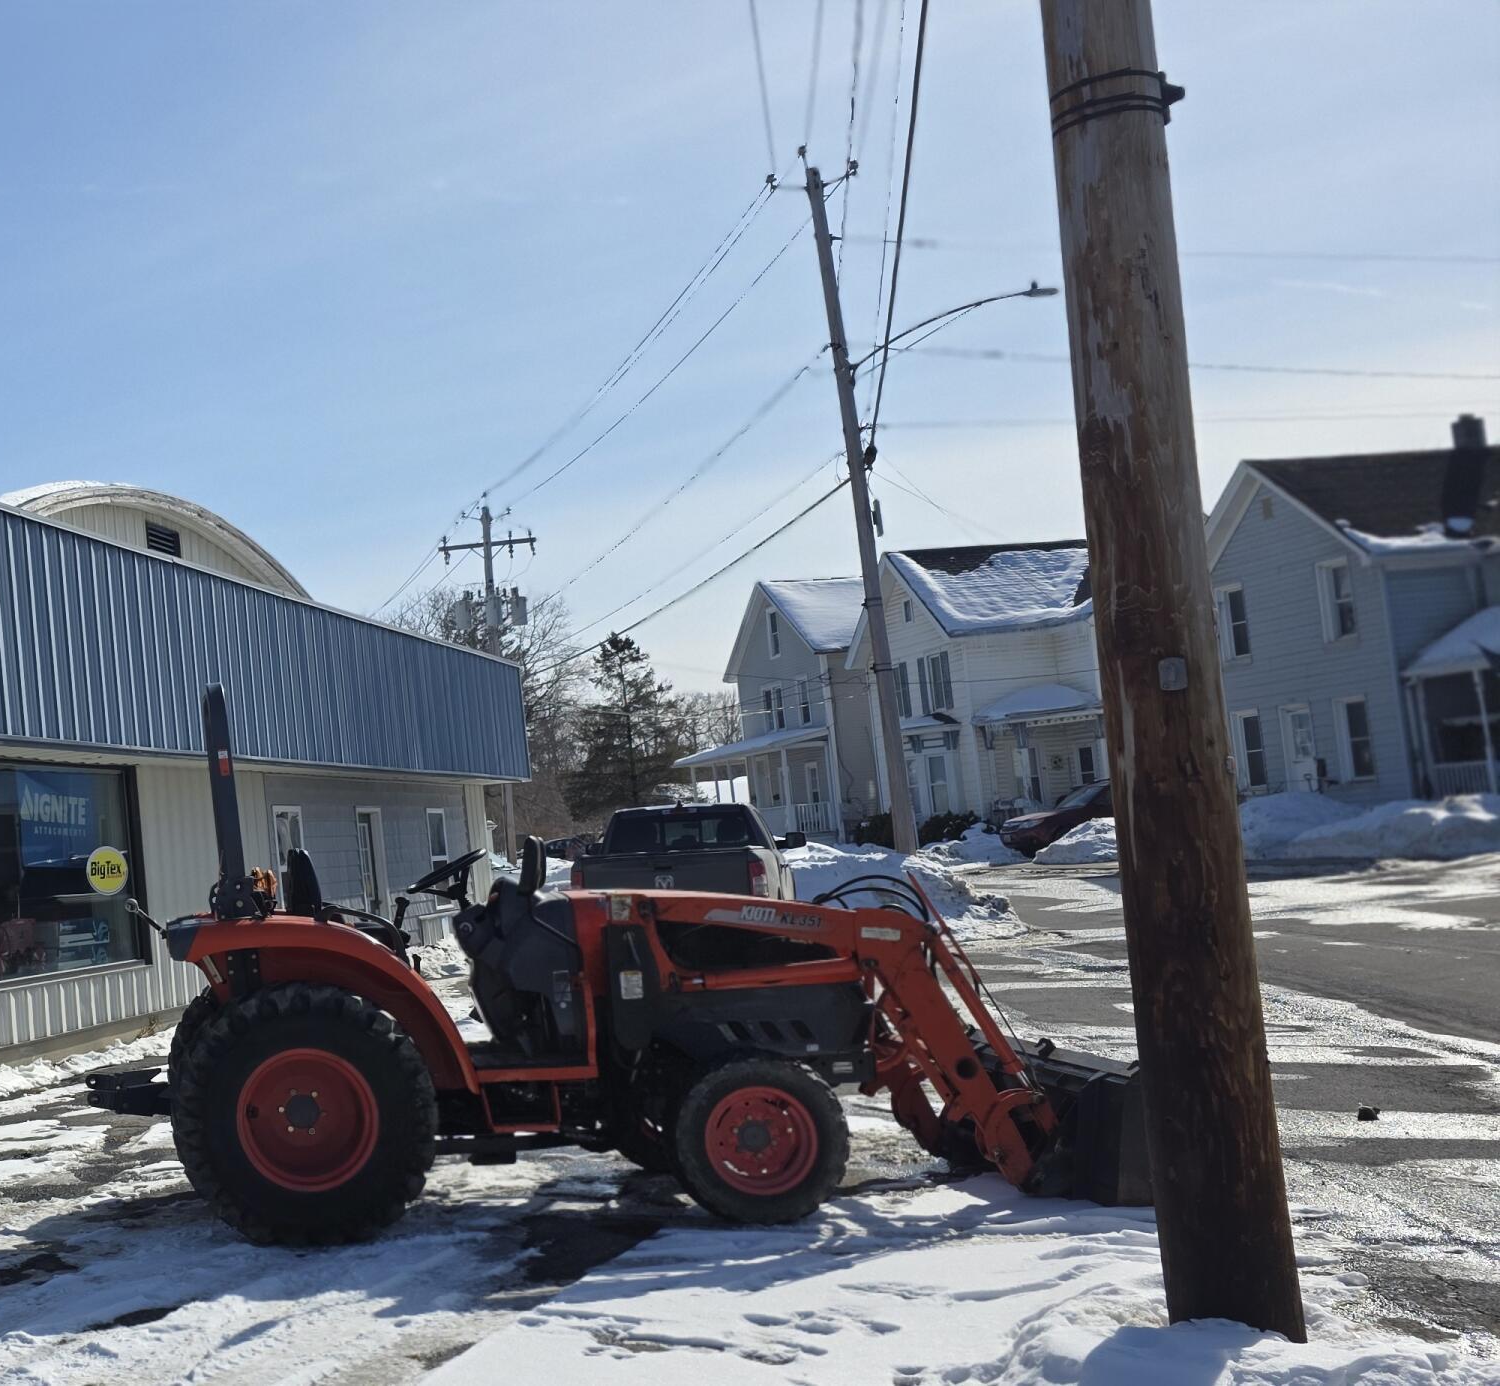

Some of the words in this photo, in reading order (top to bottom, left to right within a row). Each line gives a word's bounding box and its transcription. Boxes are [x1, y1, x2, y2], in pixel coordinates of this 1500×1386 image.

[34, 792, 87, 825] IGNITE
[90, 861, 122, 879] BigTex
[739, 904, 776, 922] KIOTI
